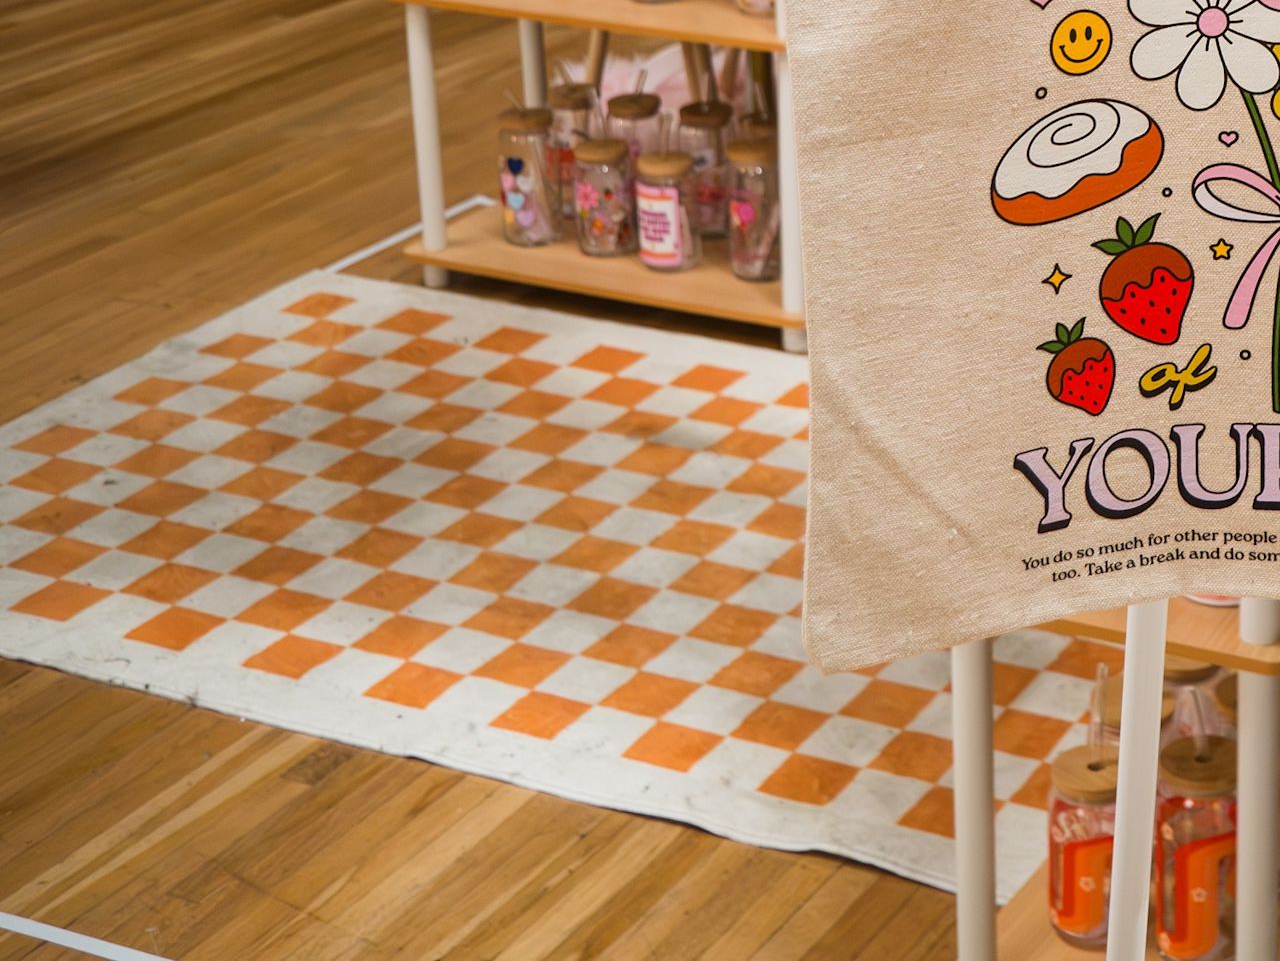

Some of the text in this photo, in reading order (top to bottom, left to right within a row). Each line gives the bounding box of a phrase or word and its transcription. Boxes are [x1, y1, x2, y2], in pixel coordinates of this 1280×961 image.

[1139, 343, 1217, 411] of
[1021, 556, 1051, 571] You
[1052, 549, 1073, 564] do
[1076, 547, 1095, 559] so
[1098, 536, 1145, 556] much
[1147, 533, 1171, 547] for
[1173, 528, 1220, 543] other
[1223, 530, 1278, 546] people
[1051, 568, 1081, 583] too.
[1084, 560, 1123, 577] Take
[1125, 558, 1137, 570] a
[1139, 547, 1186, 567] break
[1188, 546, 1221, 560] and
[1223, 547, 1245, 561] do
